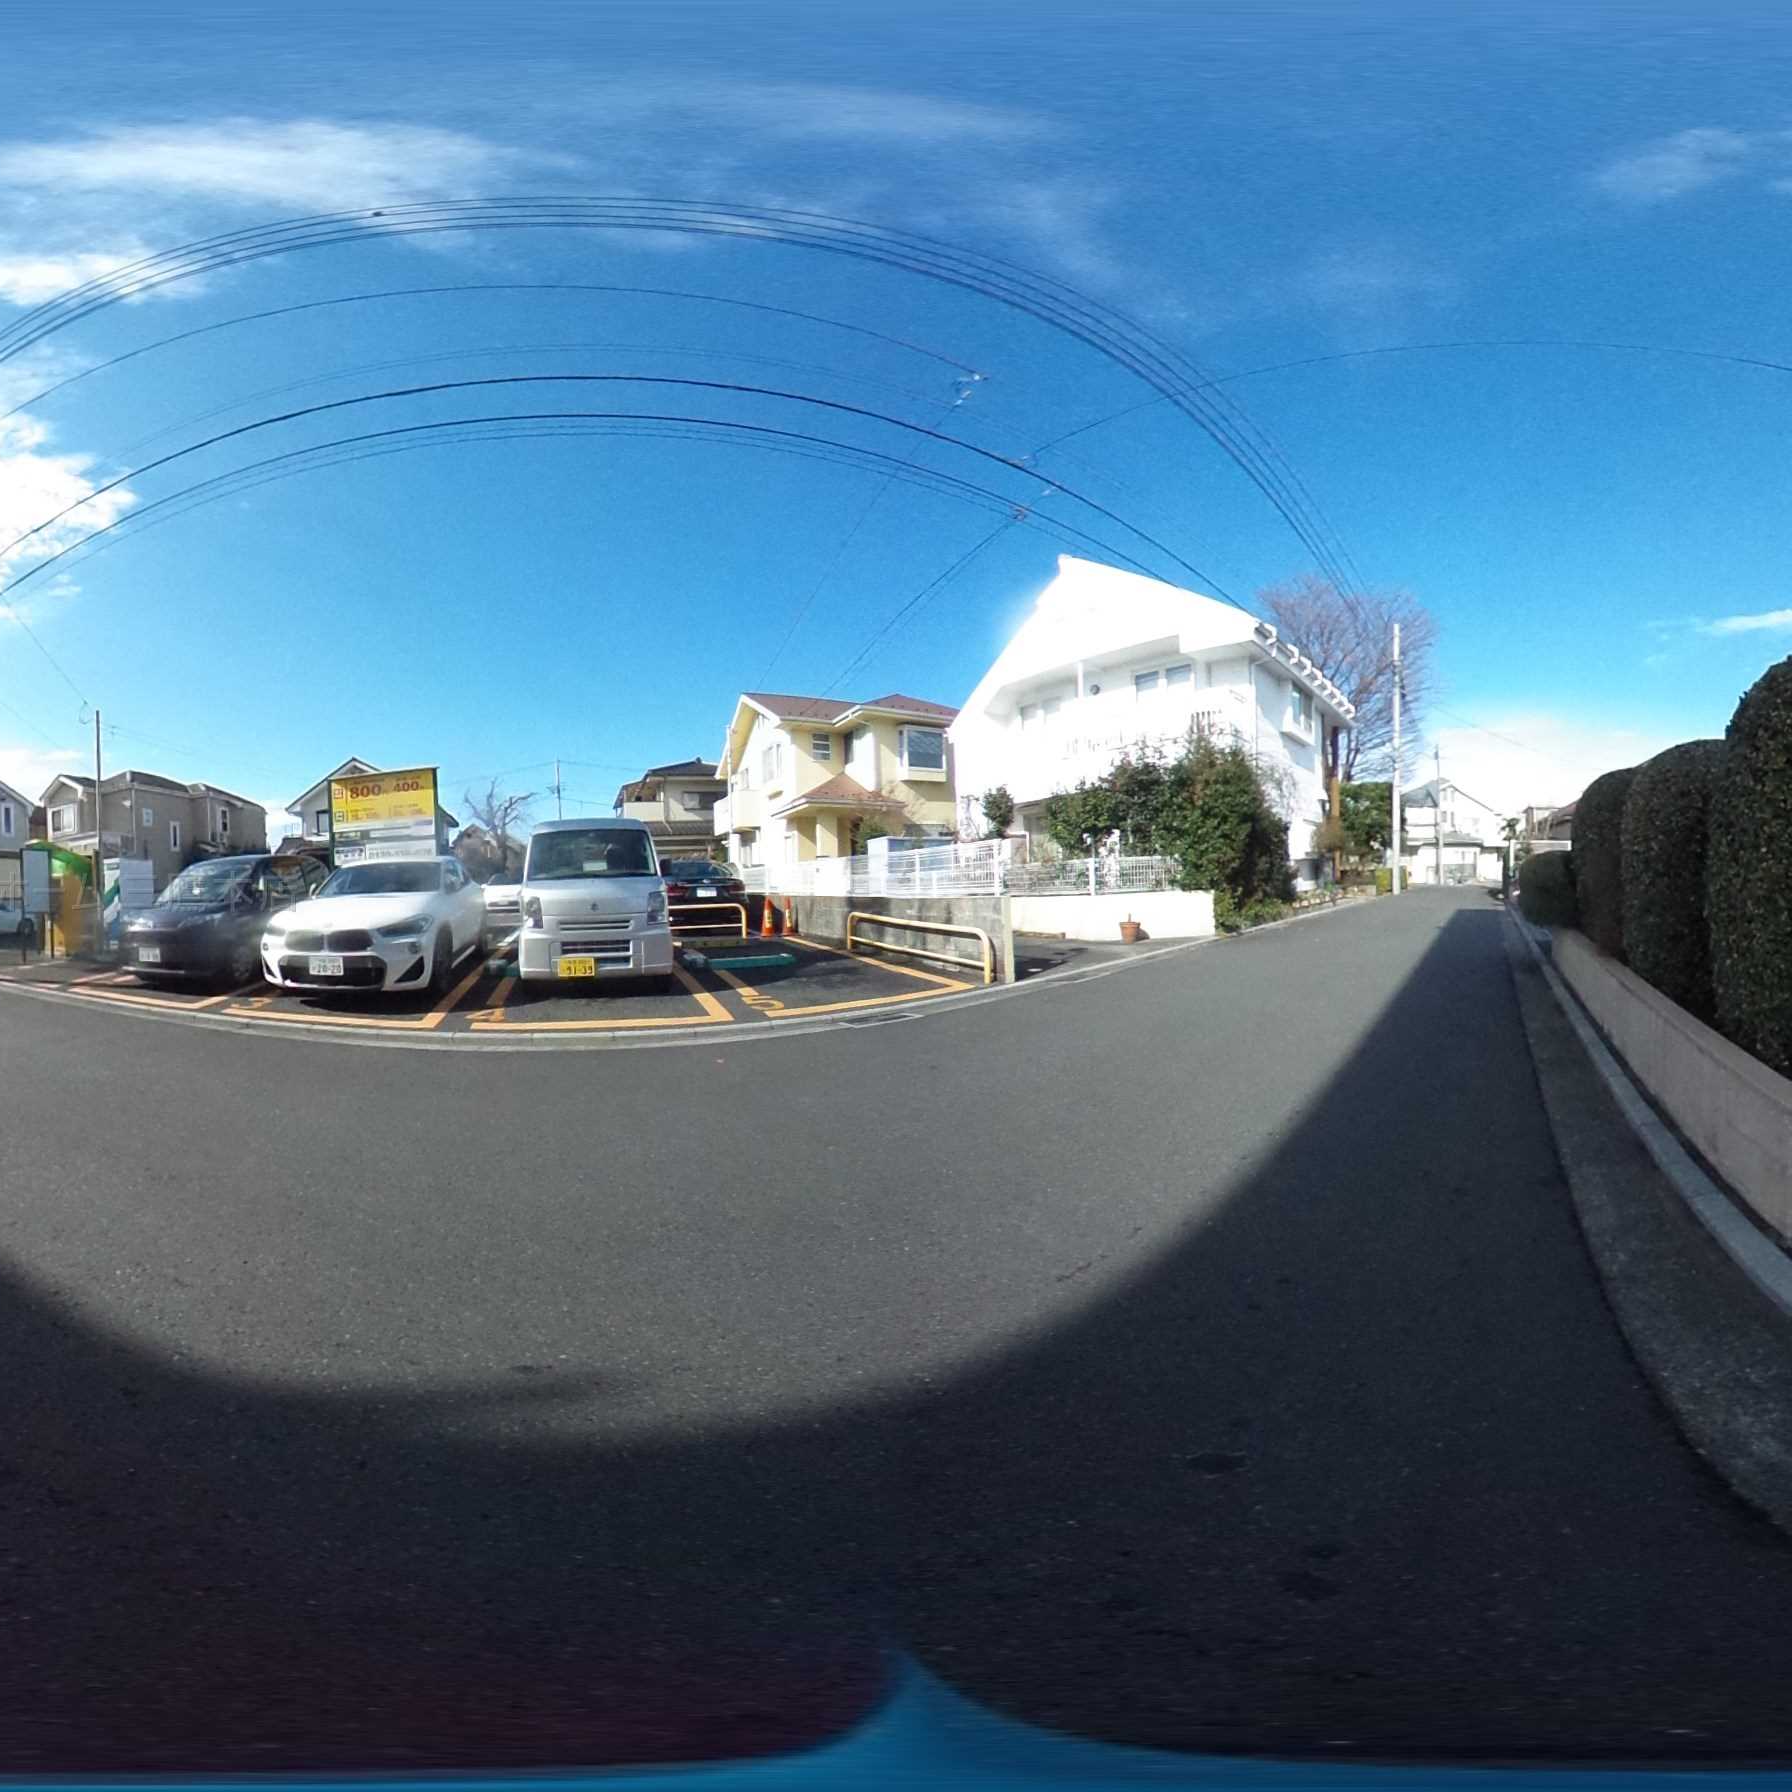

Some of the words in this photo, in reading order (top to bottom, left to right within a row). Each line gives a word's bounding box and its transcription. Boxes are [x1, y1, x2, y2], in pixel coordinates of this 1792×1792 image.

[350, 784, 382, 799] 800
[393, 781, 419, 793] 400
[741, 995, 785, 1011] 5
